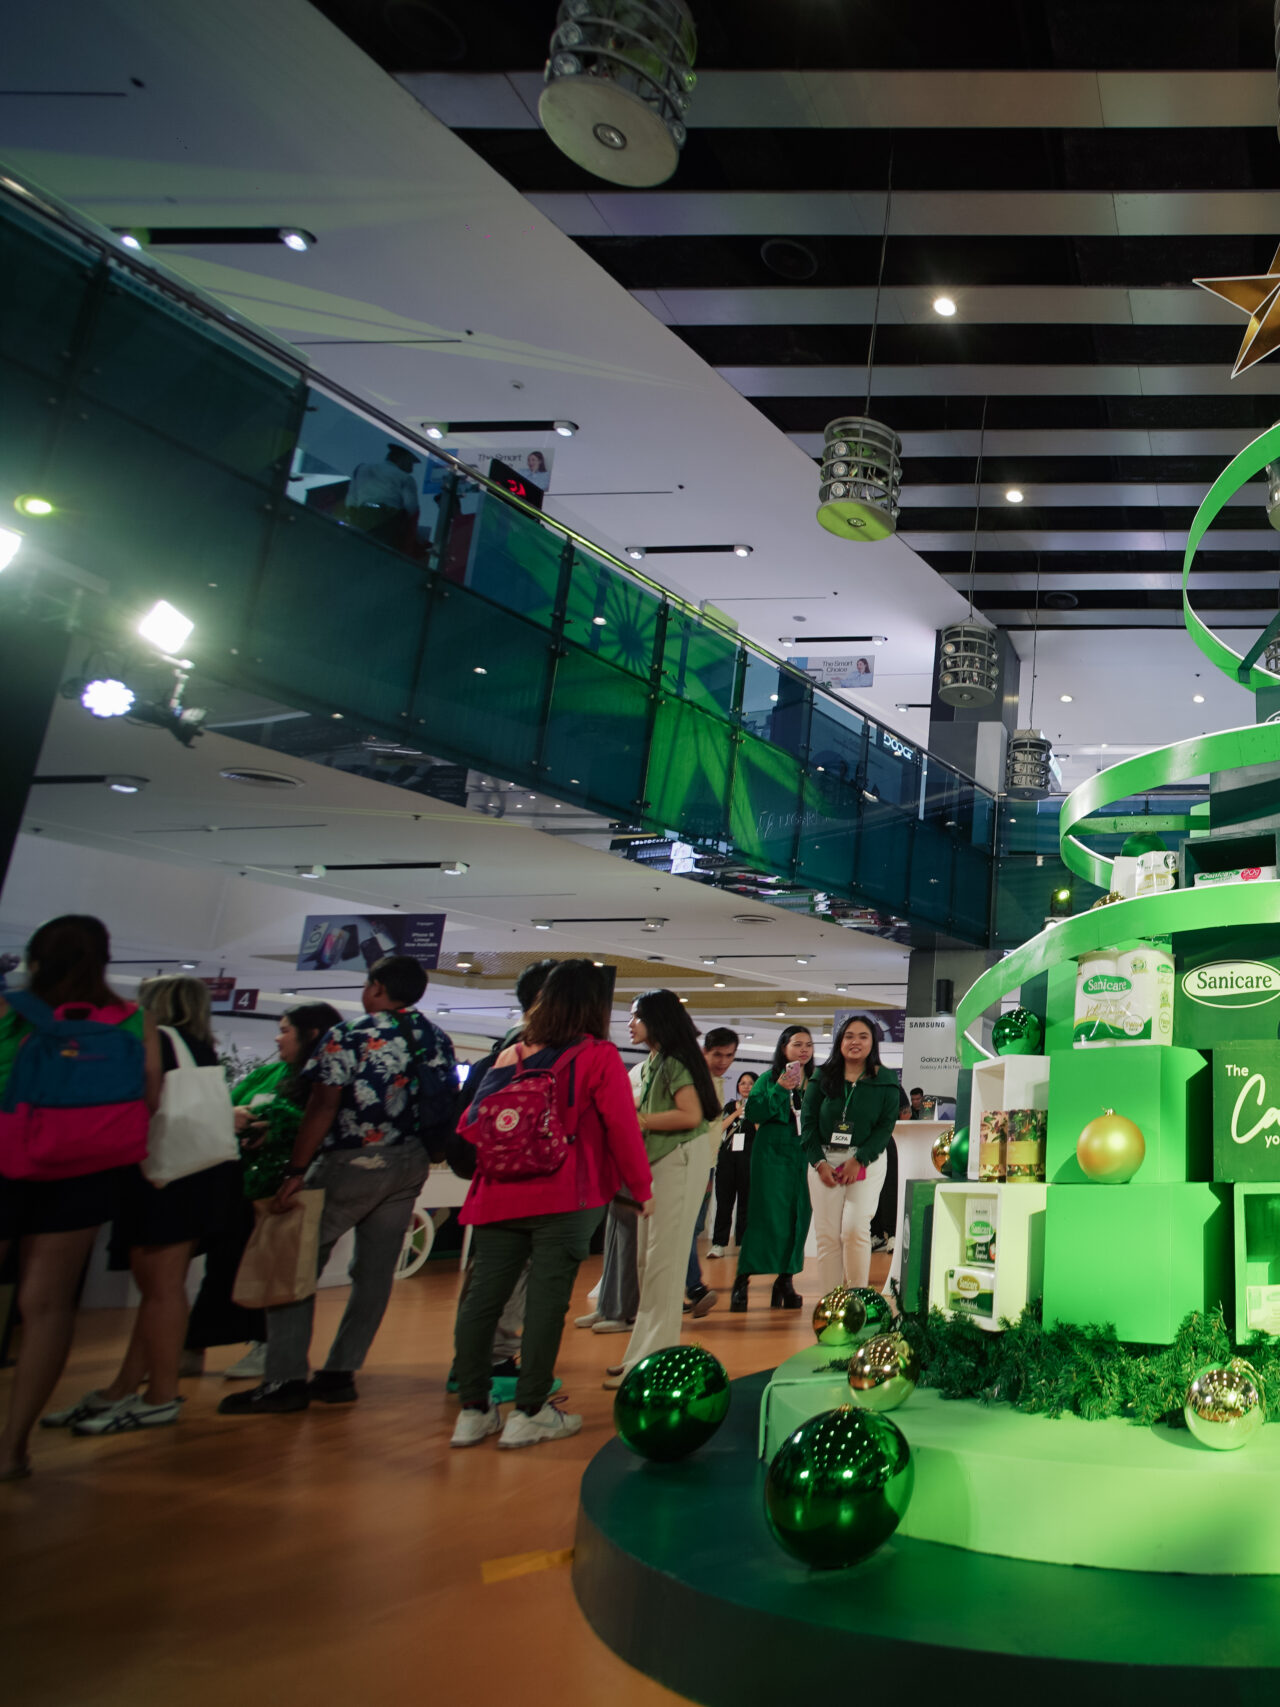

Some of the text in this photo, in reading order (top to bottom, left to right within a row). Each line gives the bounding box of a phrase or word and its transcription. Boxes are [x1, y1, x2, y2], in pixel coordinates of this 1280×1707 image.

[1088, 979, 1127, 991] Sanicare
[1197, 971, 1272, 990] Sanicare
[238, 992, 250, 1007] 4
[920, 1056, 944, 1064] Galaxy
[1225, 1064, 1249, 1076] The
